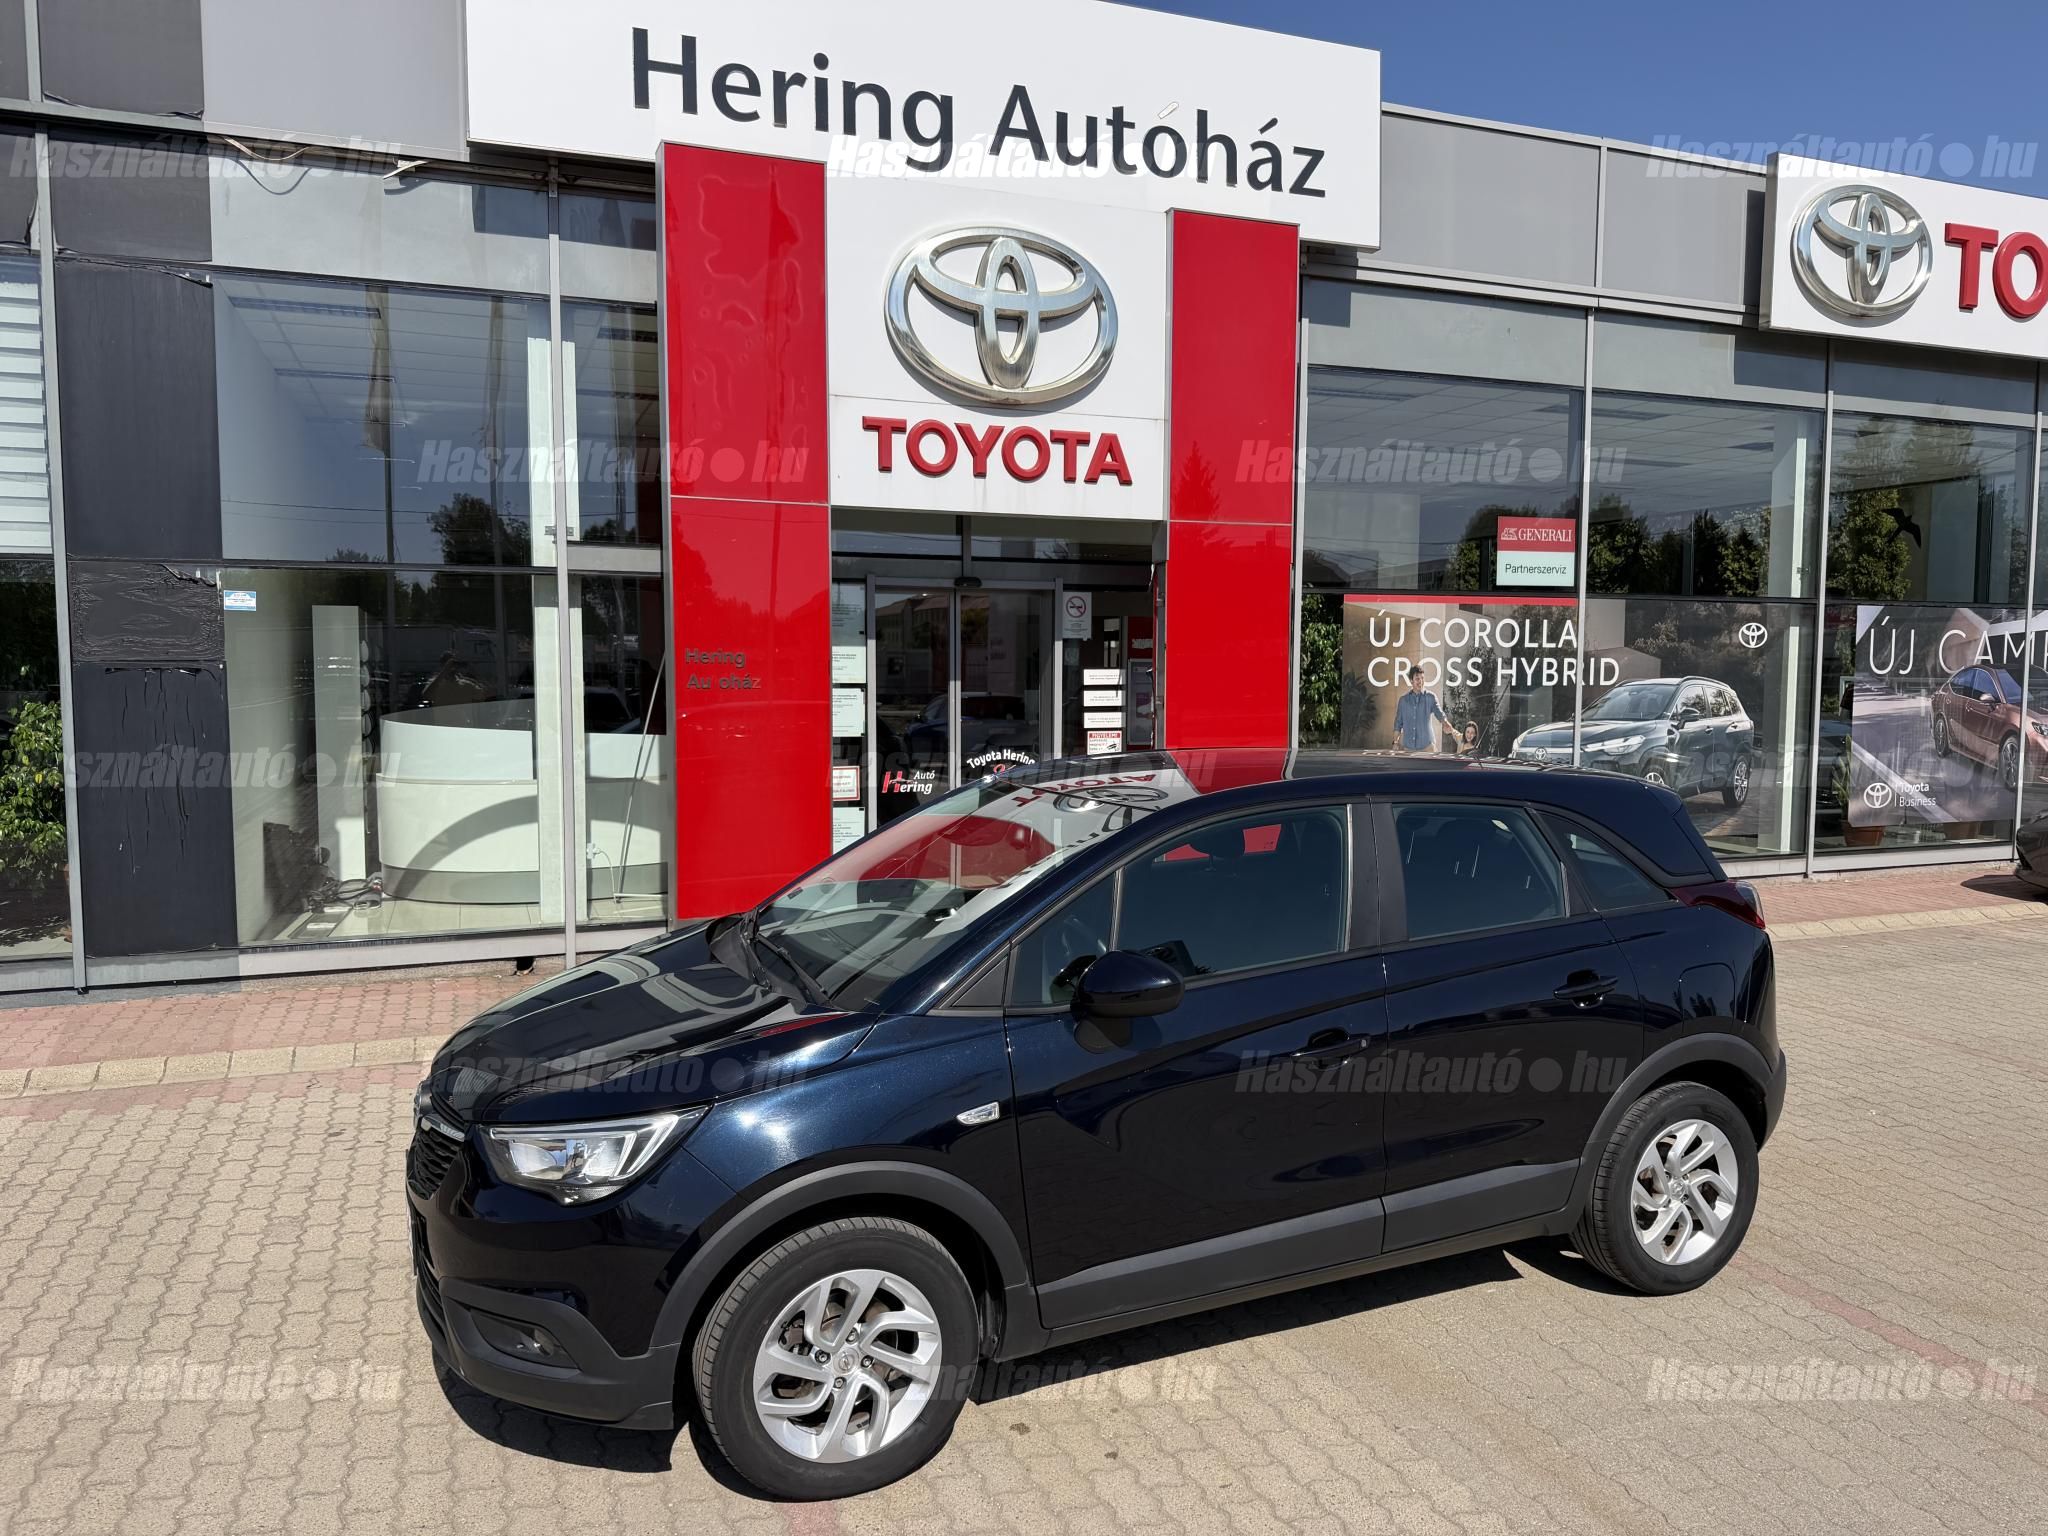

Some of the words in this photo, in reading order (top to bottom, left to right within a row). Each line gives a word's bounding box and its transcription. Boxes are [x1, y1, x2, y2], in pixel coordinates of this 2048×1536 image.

[632, 27, 953, 172] Hering
[988, 84, 1326, 198] Autóház
[1944, 222, 2048, 322] TO
[862, 416, 1133, 486] TOYOTA
[1519, 528, 1572, 542] GENERALI
[1505, 563, 1567, 575] Partnerszerviz
[1369, 609, 1406, 648] ÚJ
[1420, 618, 1578, 648] COROLLA
[1870, 616, 1915, 675] ÚJ
[1938, 629, 2048, 675] CAM
[685, 647, 746, 669] Hering
[1367, 657, 1483, 688] CROSS
[1497, 657, 1620, 688] HYBRID
[966, 750, 1001, 769] Toyota
[882, 771, 933, 794] Hering
[913, 770, 935, 780] Autó
[1900, 782, 1930, 794] Toyota
[1900, 796, 1937, 807] Business
